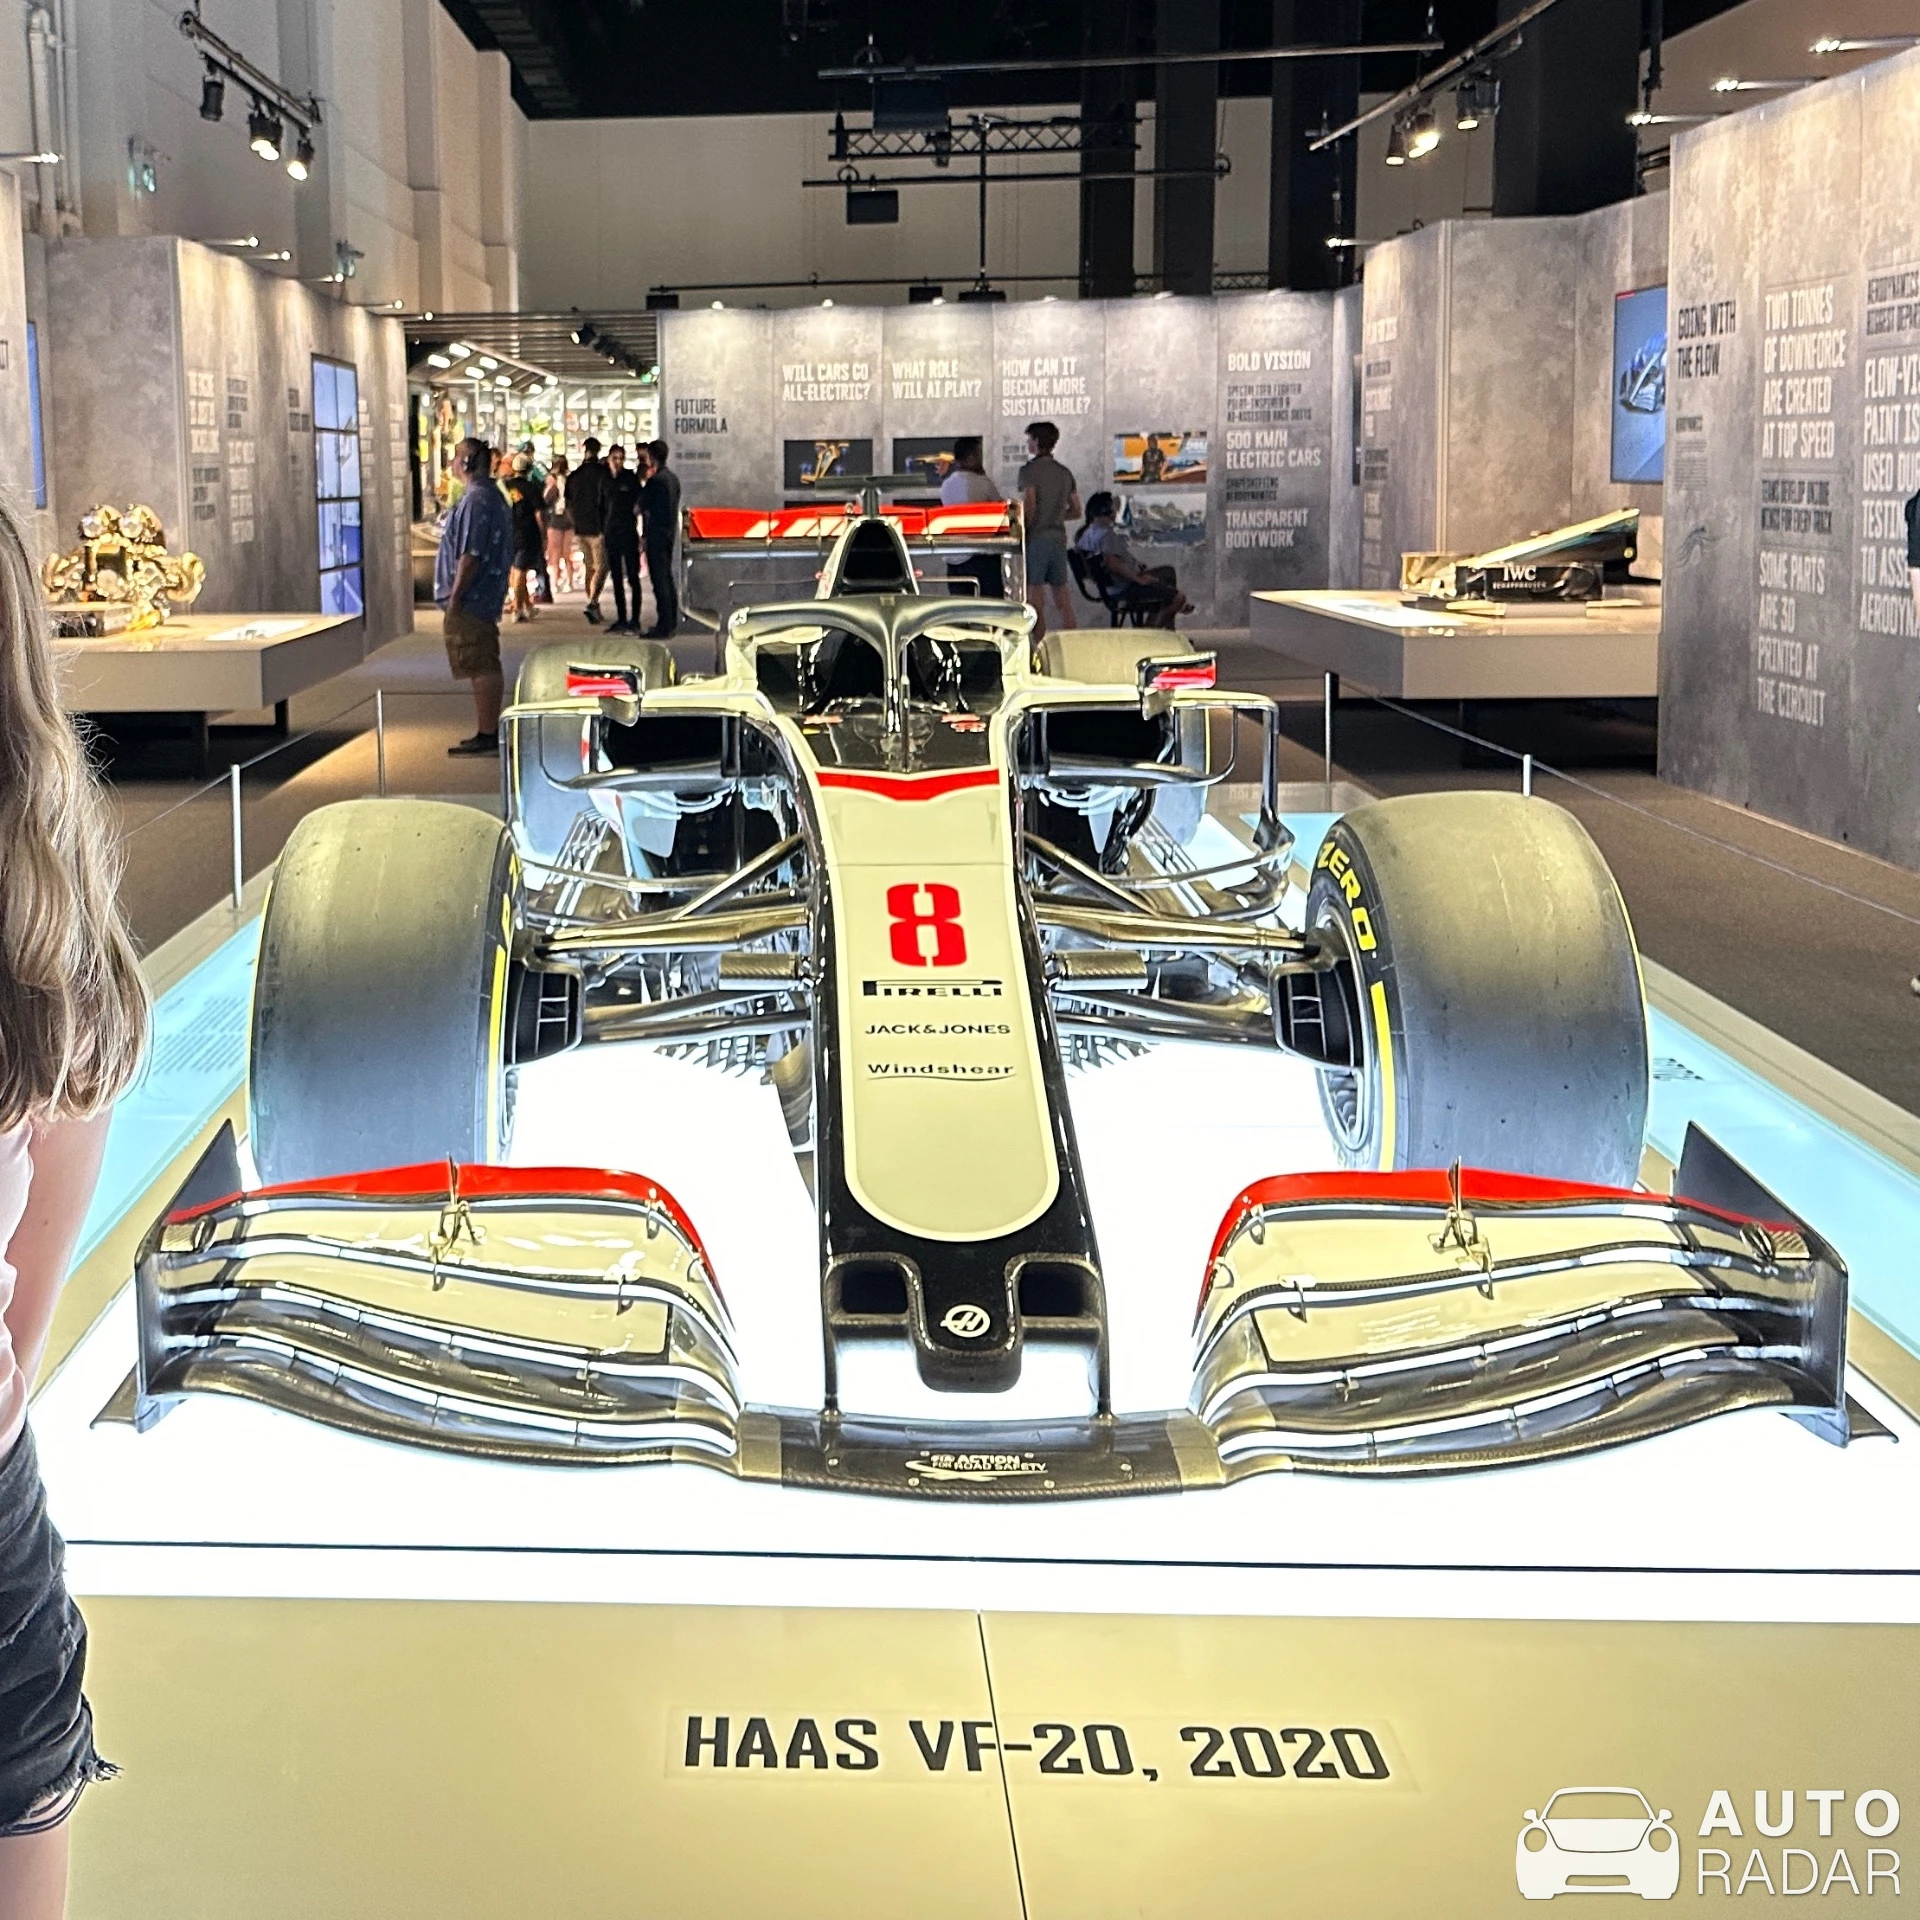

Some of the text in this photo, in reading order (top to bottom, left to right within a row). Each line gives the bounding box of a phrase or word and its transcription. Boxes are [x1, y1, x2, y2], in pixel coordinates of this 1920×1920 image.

[1765, 291, 1789, 331] TWO
[1792, 284, 1834, 327] TONNES
[1679, 301, 1736, 340] GOING WITH
[1227, 350, 1311, 371] BOLD VISION
[1678, 342, 1720, 379] THE FLOW
[1764, 329, 1846, 374] OF DOWNFORCE
[782, 363, 869, 382] WILL CARS GO
[892, 359, 959, 379] WHAT ROLE
[1002, 357, 1077, 377] HOW CAN IT
[782, 382, 871, 401] ALL-ELECTRIC?
[892, 379, 982, 399] WILL AI PLAY?
[1002, 377, 1086, 396] BECOME MORE
[1763, 376, 1831, 416] ARE CREATED
[675, 398, 717, 415] FUTURE
[1002, 397, 1091, 416] SUSTAINABLE?
[675, 418, 728, 434] FORMULA
[1864, 402, 1920, 445] PAINT IS
[1226, 429, 1251, 450] 500
[1255, 429, 1288, 449] KM/H
[1762, 421, 1835, 459] AT TOP SPEED
[1226, 447, 1321, 470] ELECTRIC CARS
[1863, 452, 1893, 492] USED
[1225, 508, 1309, 529] TRANSPARENT
[1862, 499, 1907, 539] TESTIN
[1225, 529, 1295, 549] BODYWORK
[1503, 563, 1536, 581] IWC
[1759, 550, 1825, 595] SOME PARTS
[1860, 545, 1876, 586] TO
[1759, 592, 1796, 634] ARE 3D
[1758, 635, 1819, 682] PRINTED AT
[1758, 676, 1826, 728] THE CIRCUIT
[1317, 841, 1377, 951] ZERO
[886, 883, 967, 967] 8
[862, 979, 1003, 996] PIRELLI
[865, 1024, 1011, 1034] JACK&JONES
[868, 1064, 1015, 1074] Windshear
[954, 1462, 992, 1470] ROAD
[995, 1462, 1046, 1471] SAFETY
[957, 1455, 1020, 1465] ACTION
[684, 1715, 1391, 1782] HAAS VF-20, 2020
